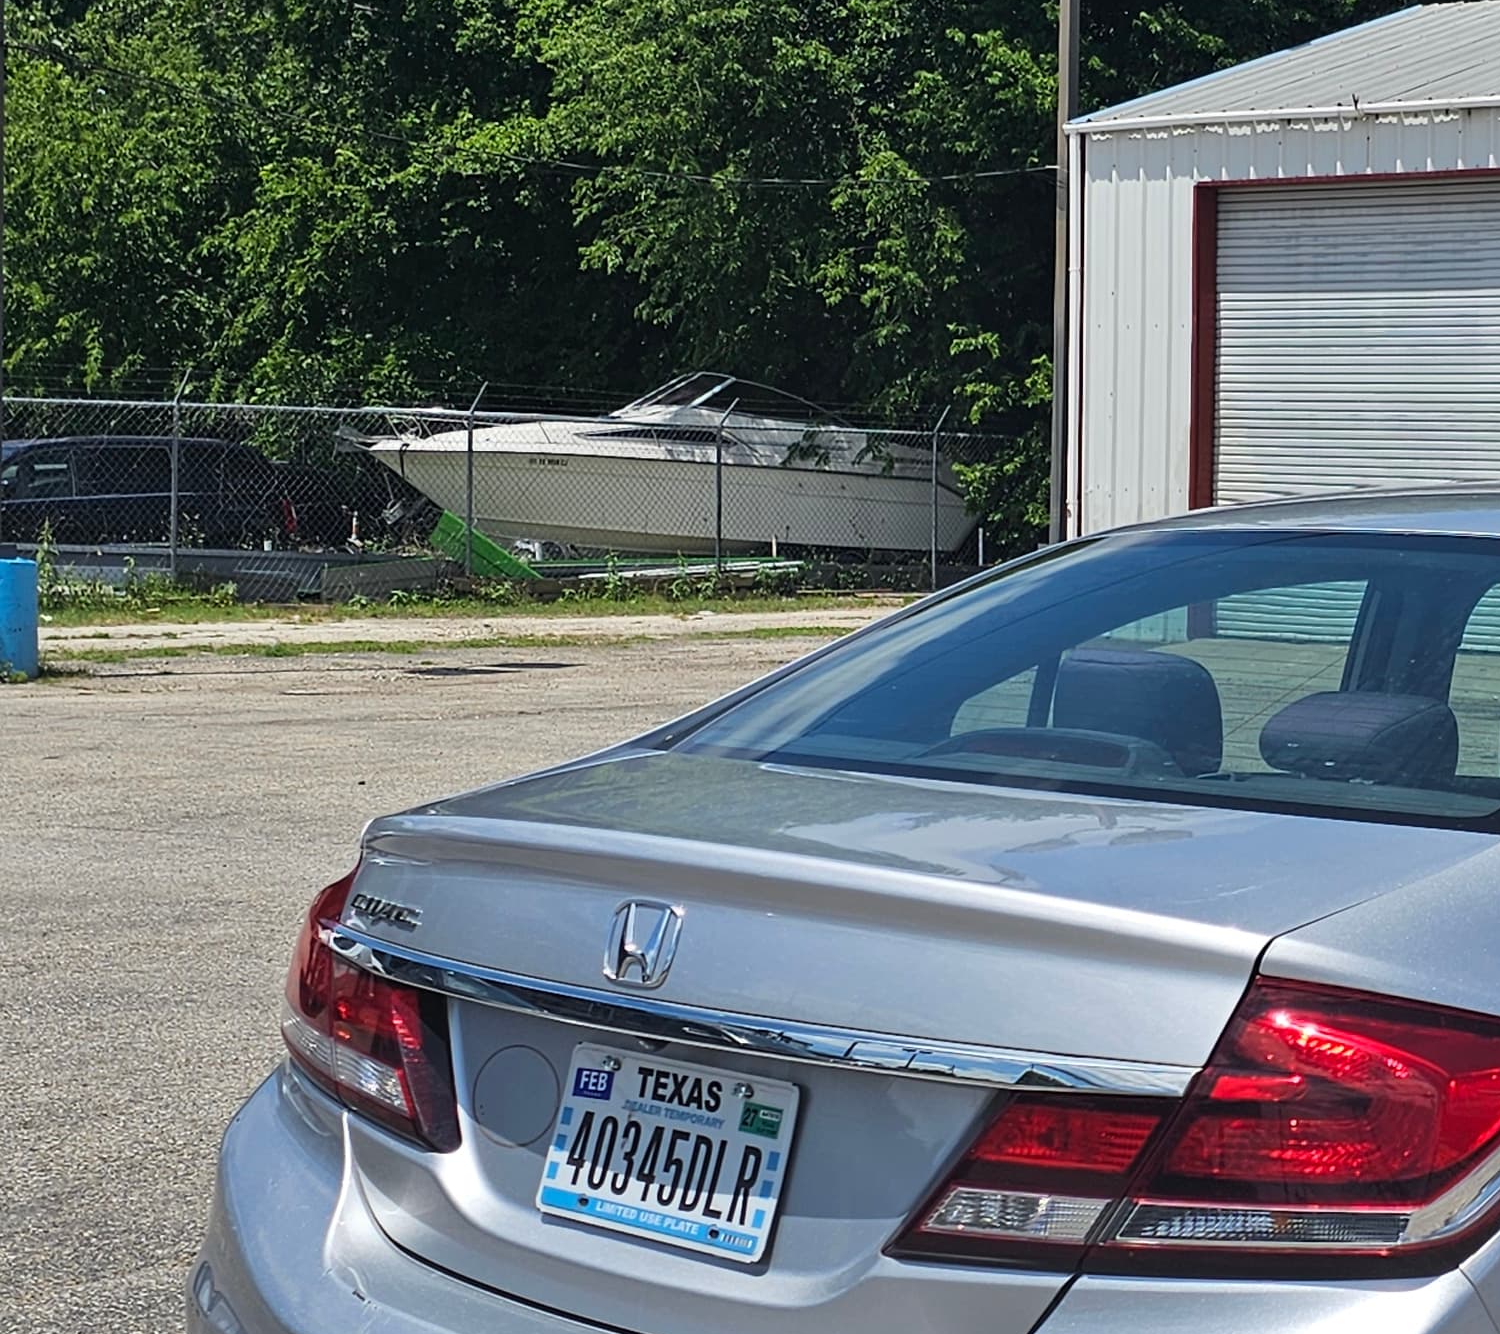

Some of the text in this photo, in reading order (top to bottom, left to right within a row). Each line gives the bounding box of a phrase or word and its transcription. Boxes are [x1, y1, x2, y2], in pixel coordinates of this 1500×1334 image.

[579, 1070, 609, 1092] FEB
[637, 1066, 724, 1113] TEXAS
[621, 1099, 726, 1130] DEALER TEMPORARY
[566, 1110, 763, 1226] 40345DLR
[595, 1200, 700, 1235] LIMITED USE PLATE
